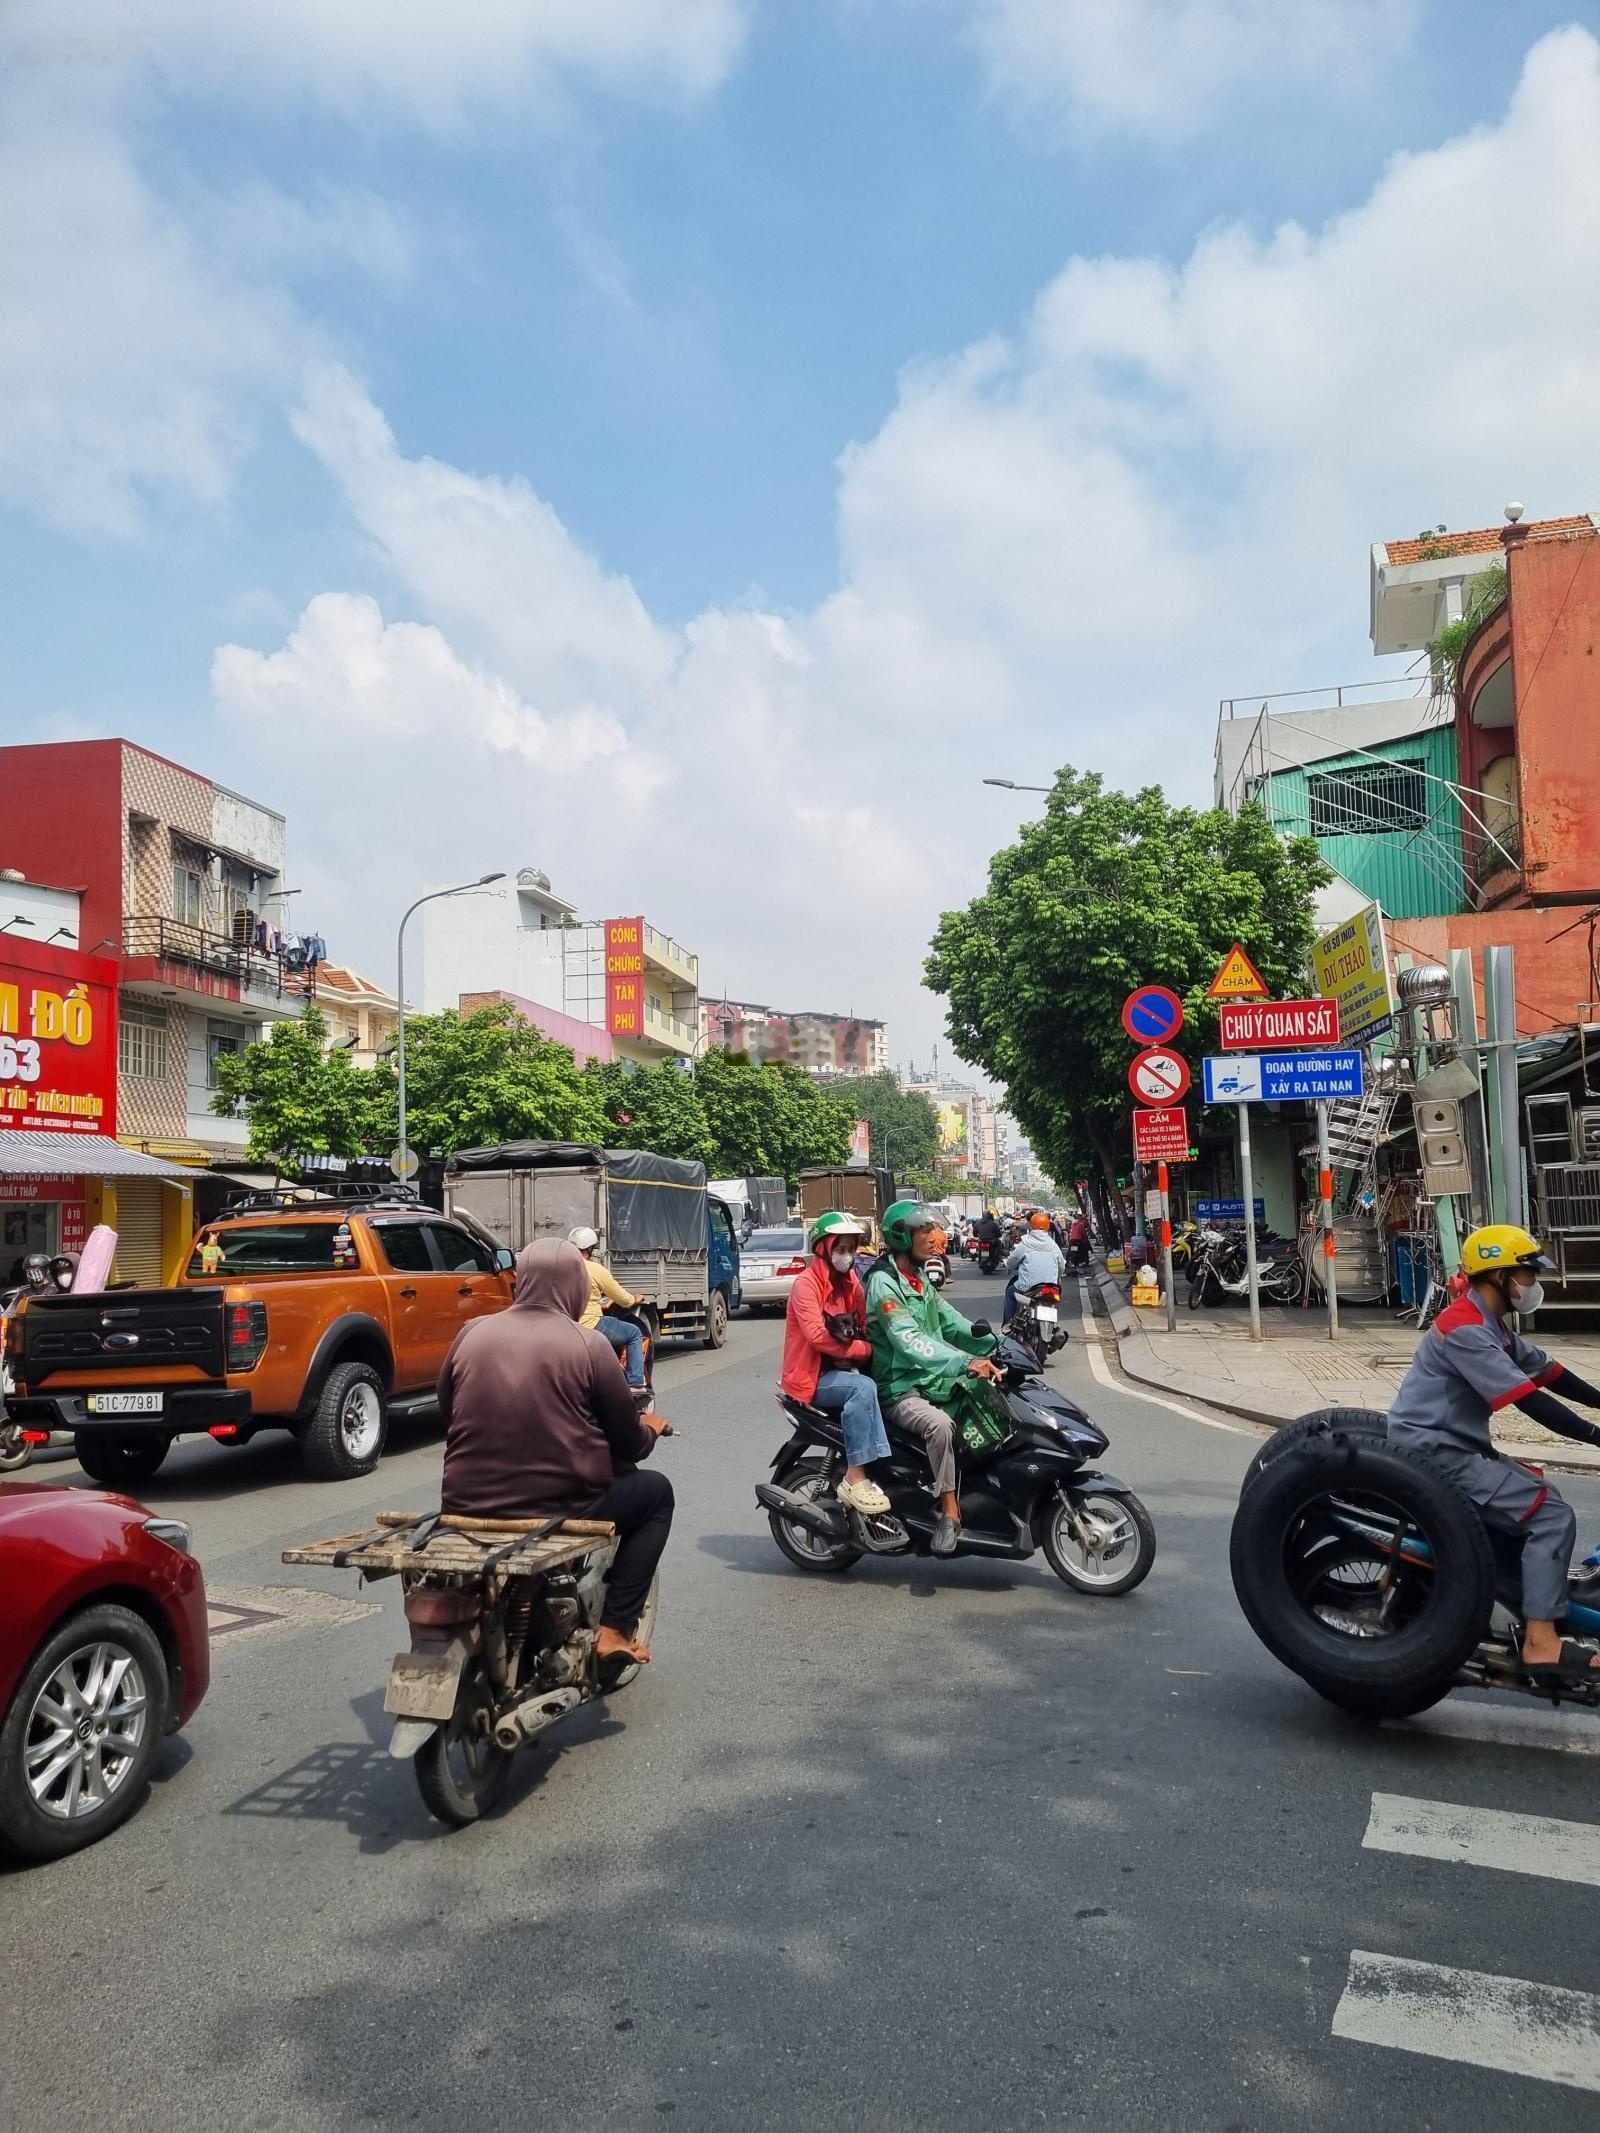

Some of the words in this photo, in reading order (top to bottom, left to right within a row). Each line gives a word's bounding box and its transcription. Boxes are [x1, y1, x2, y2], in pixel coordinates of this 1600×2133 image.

[610, 923, 638, 943] CÔNG
[1340, 924, 1356, 943] INOX
[607, 952, 641, 972] CHỨNG
[1232, 964, 1243, 973] ĐI
[1338, 942, 1366, 978] THẢO
[614, 981, 635, 1001] TÂN
[1222, 976, 1254, 988] CHẬM
[29, 983, 93, 1046] ĐỒ
[614, 1008, 635, 1029] PHÚ
[1225, 1009, 1252, 1040] CHÚ
[1254, 1008, 1263, 1038] Ý
[1265, 1011, 1305, 1038] QUAN
[1307, 1004, 1333, 1036] SÁT
[1265, 1062, 1293, 1075] ĐOẠN
[1297, 1057, 1332, 1073] ĐƯỜNG
[1335, 1058, 1354, 1071] HAY
[1271, 1079, 1289, 1094] XẢY
[1294, 1081, 1309, 1093] RA
[1311, 1081, 1327, 1092] TAI
[1330, 1080, 1353, 1094] NẠN
[1149, 1111, 1169, 1124] CẤM
[97, 1395, 159, 1411] 51C-779.81
